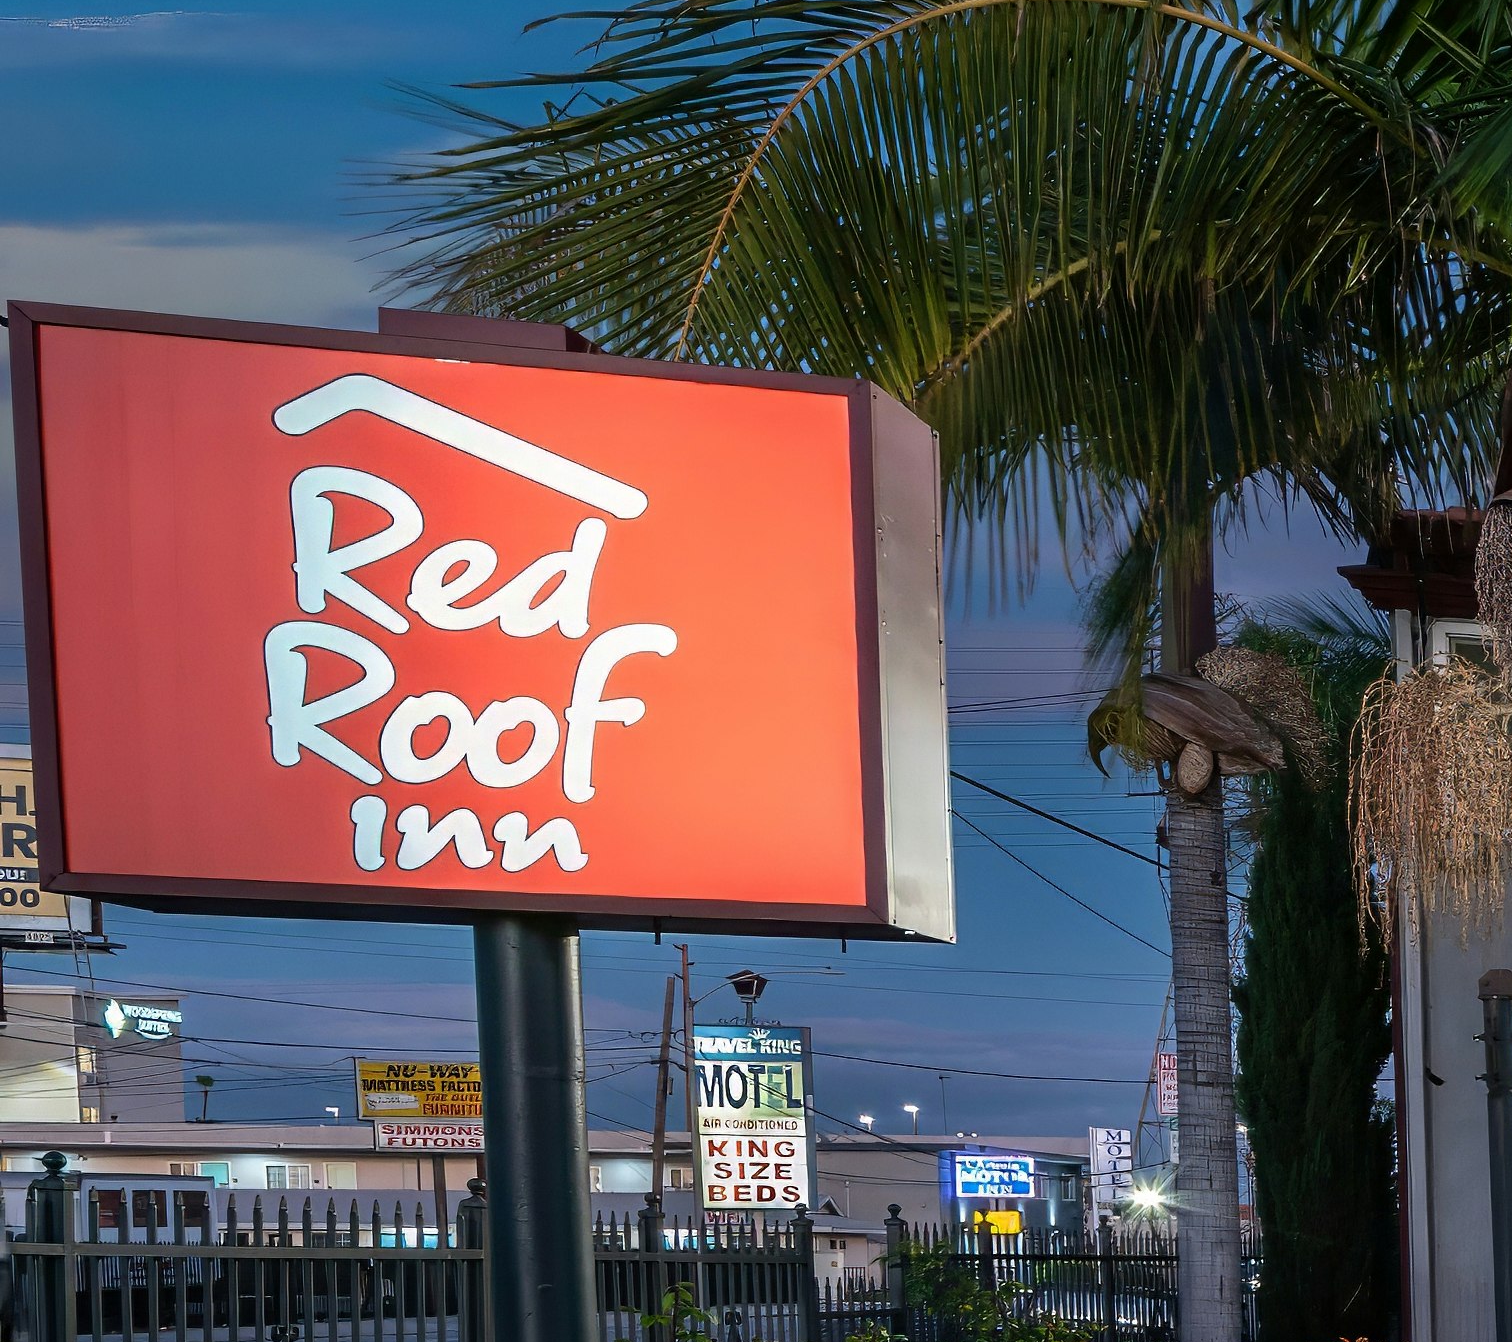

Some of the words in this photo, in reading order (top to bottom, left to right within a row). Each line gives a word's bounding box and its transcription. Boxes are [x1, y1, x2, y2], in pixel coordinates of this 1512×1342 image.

[289, 465, 607, 639] Red
[264, 620, 678, 804] Roof
[760, 1039, 802, 1055] KING
[695, 1065, 802, 1109] MOTEL
[381, 1124, 484, 1136] SIMMONS
[703, 1119, 721, 1128] AIR
[725, 1120, 798, 1130] CONDITIONED
[387, 1137, 481, 1147] FUTONS
[707, 1139, 796, 1158] KING
[713, 1162, 793, 1180] SIZE
[707, 1184, 801, 1203] BEDS
